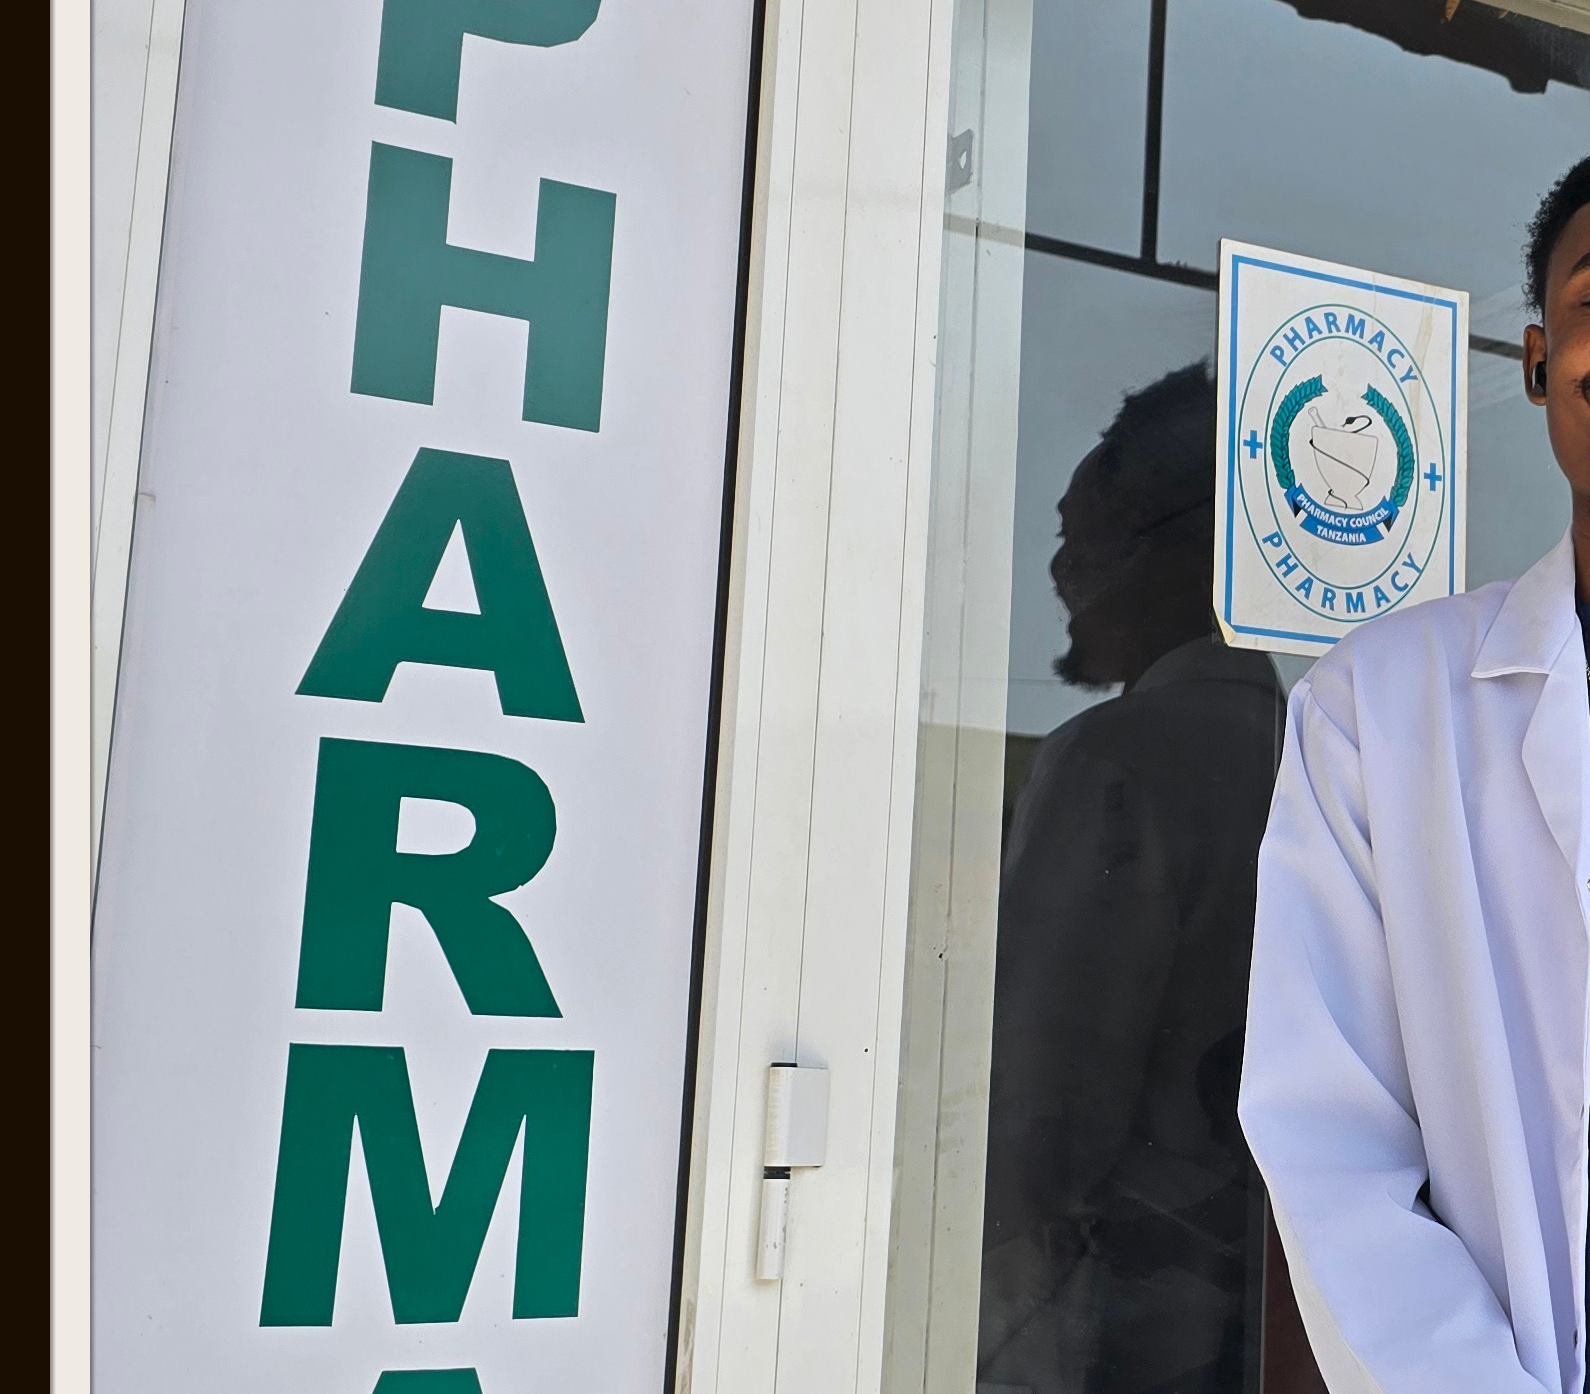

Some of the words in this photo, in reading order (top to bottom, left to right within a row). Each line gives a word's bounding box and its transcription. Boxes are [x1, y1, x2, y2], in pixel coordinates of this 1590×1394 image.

[1270, 312, 1418, 385] PHARMACY
[1297, 494, 1347, 527] PHARMACY
[1350, 508, 1389, 527] COUNCIL
[1317, 526, 1366, 542] TANZANIA
[1262, 531, 1423, 614] PHARMACY
